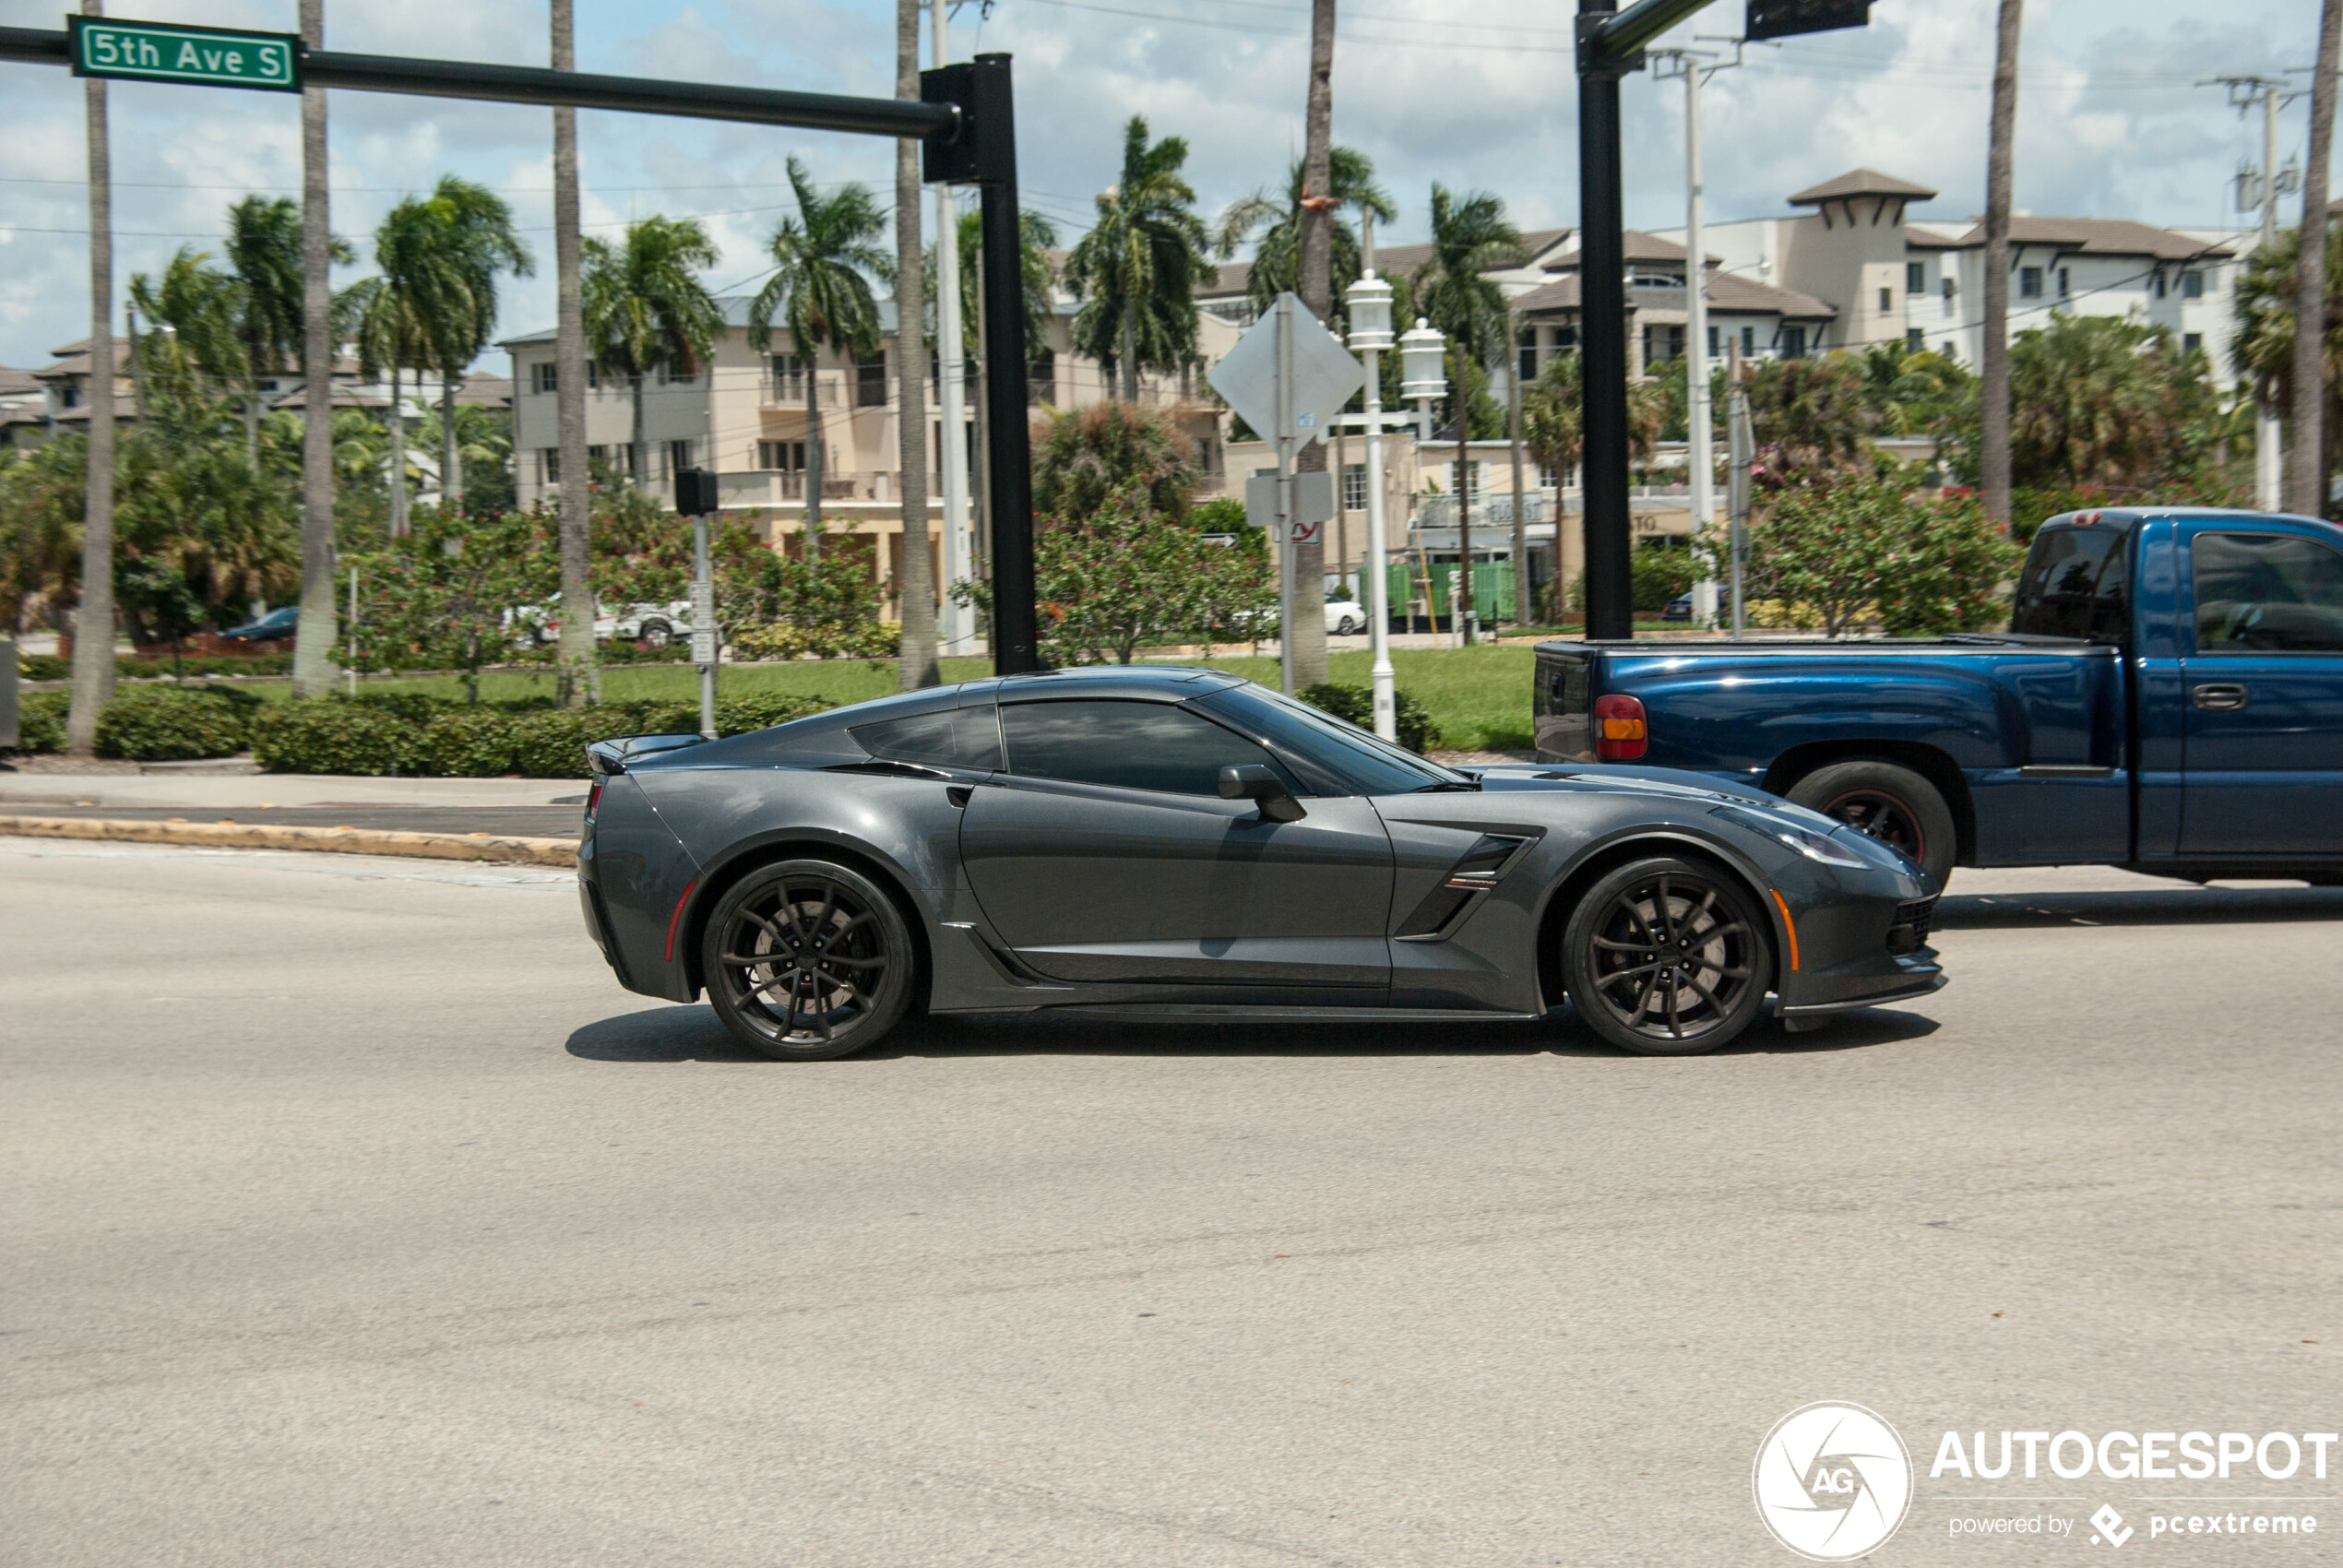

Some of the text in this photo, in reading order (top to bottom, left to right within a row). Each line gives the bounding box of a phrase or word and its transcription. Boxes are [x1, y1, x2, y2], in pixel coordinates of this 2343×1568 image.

[95, 34, 281, 77] 5th Ave S
[1490, 503, 1542, 522] FLOST
